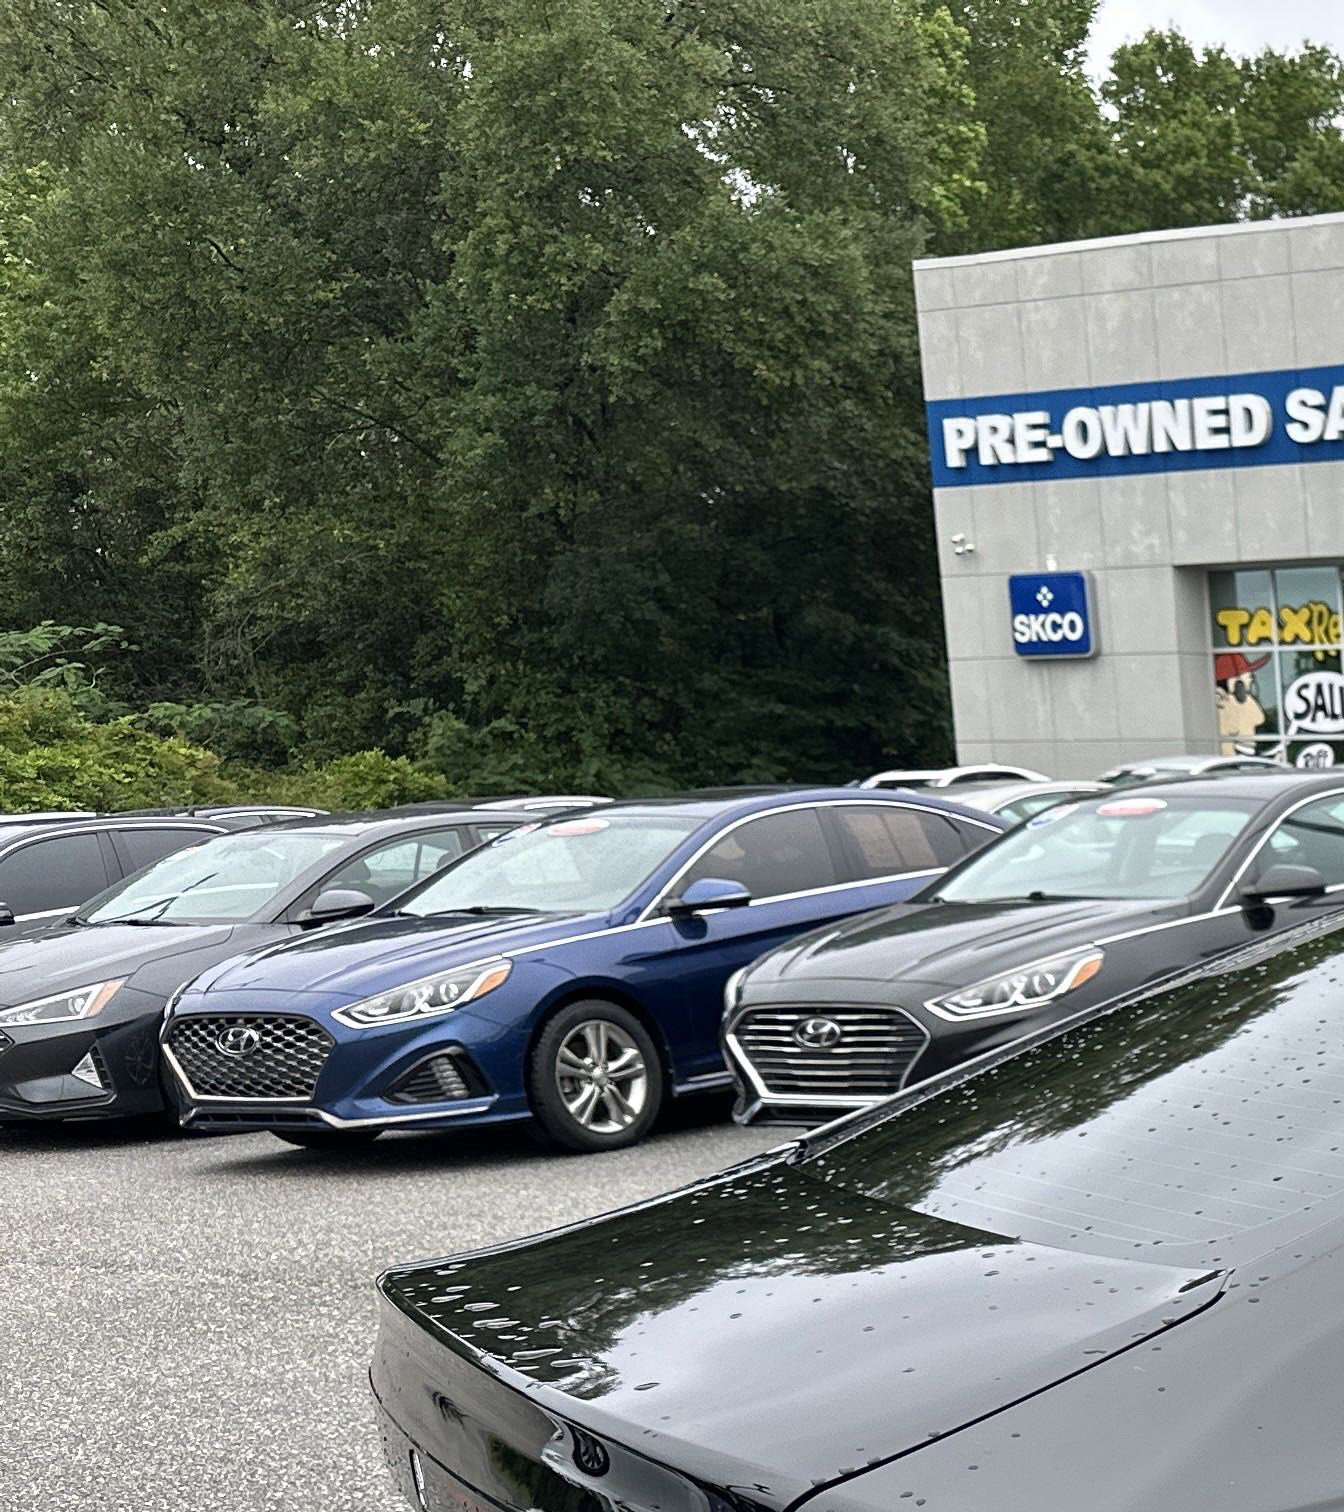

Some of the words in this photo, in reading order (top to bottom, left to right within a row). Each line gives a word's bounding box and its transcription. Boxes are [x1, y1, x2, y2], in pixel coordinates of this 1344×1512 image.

[942, 393, 1272, 468] PRE-OWNED
[1013, 611, 1084, 643] SKCO
[1216, 606, 1312, 646] TAX
